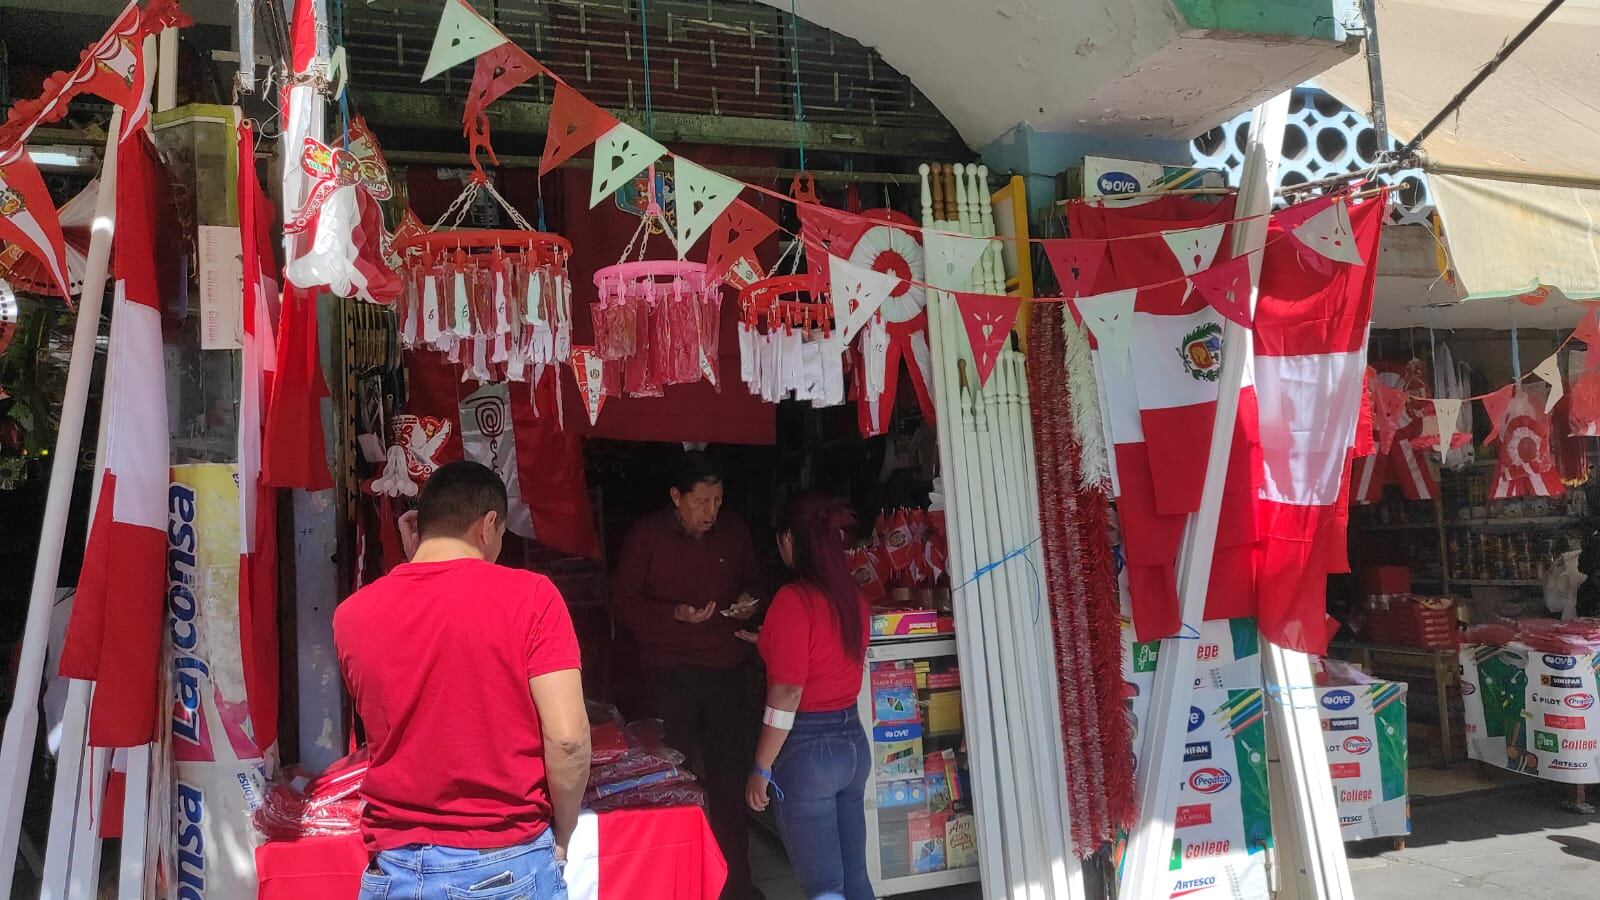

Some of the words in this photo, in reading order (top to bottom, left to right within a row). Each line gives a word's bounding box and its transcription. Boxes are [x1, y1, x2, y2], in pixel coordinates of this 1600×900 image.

[168, 485, 210, 743] Layconsa
[1540, 697, 1560, 706] PILOT
[1562, 739, 1597, 750] College
[1552, 759, 1588, 767] ARTESCO
[1341, 789, 1372, 802] College
[1185, 840, 1230, 859] College
[1174, 876, 1215, 891] ARTESCO
